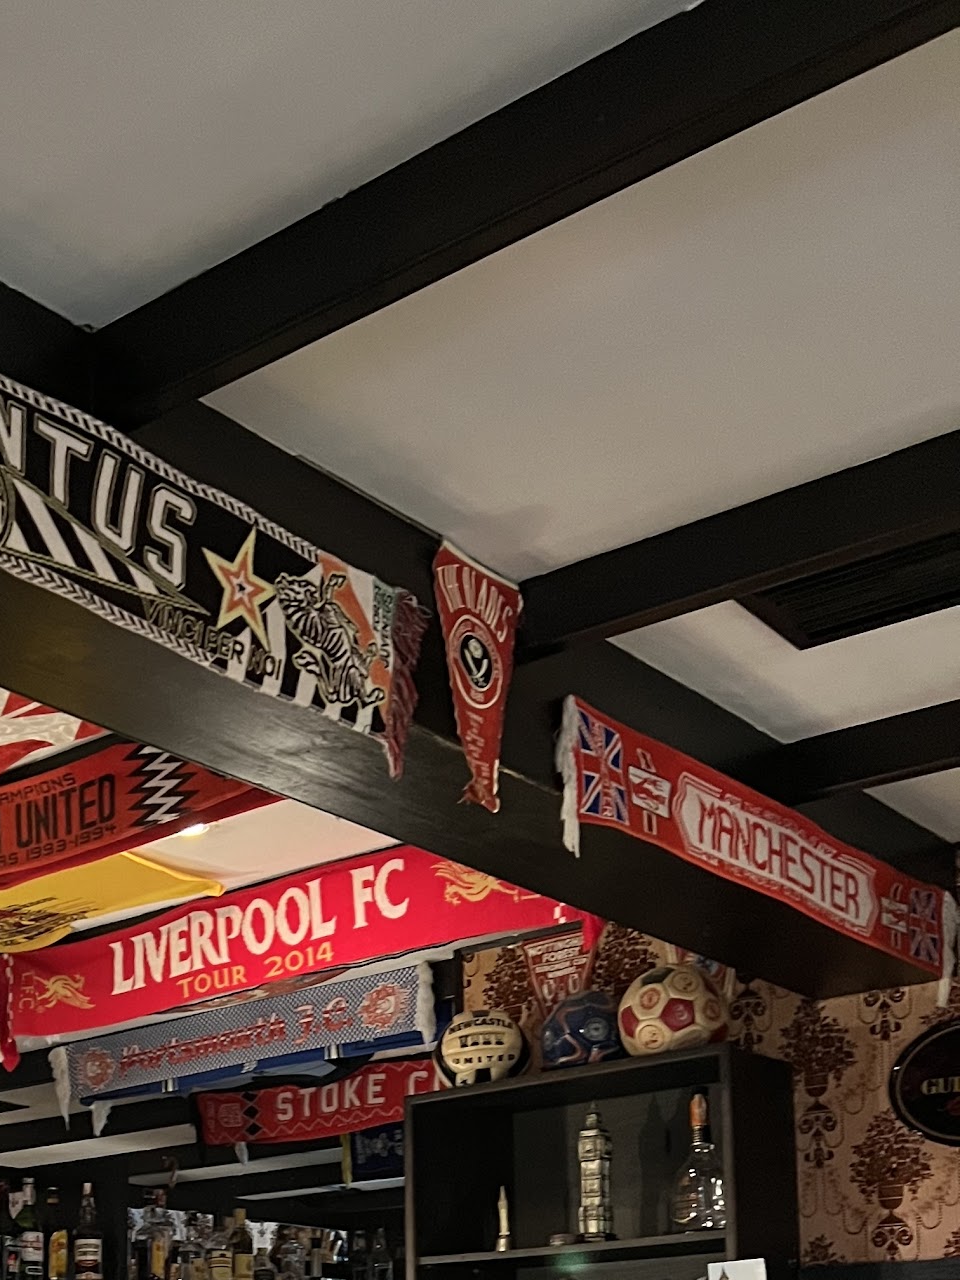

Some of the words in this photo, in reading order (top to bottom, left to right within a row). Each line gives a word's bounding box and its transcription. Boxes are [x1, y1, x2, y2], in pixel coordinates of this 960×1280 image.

[16, 772, 117, 850] UNITED
[697, 793, 861, 920] MANCHESTER
[109, 877, 338, 996] LIVERPOOL
[349, 857, 411, 930] FC
[176, 964, 248, 998] TOUR
[263, 941, 335, 979] 2014
[452, 1053, 516, 1065] UNITED
[276, 1073, 387, 1121] STOKE
